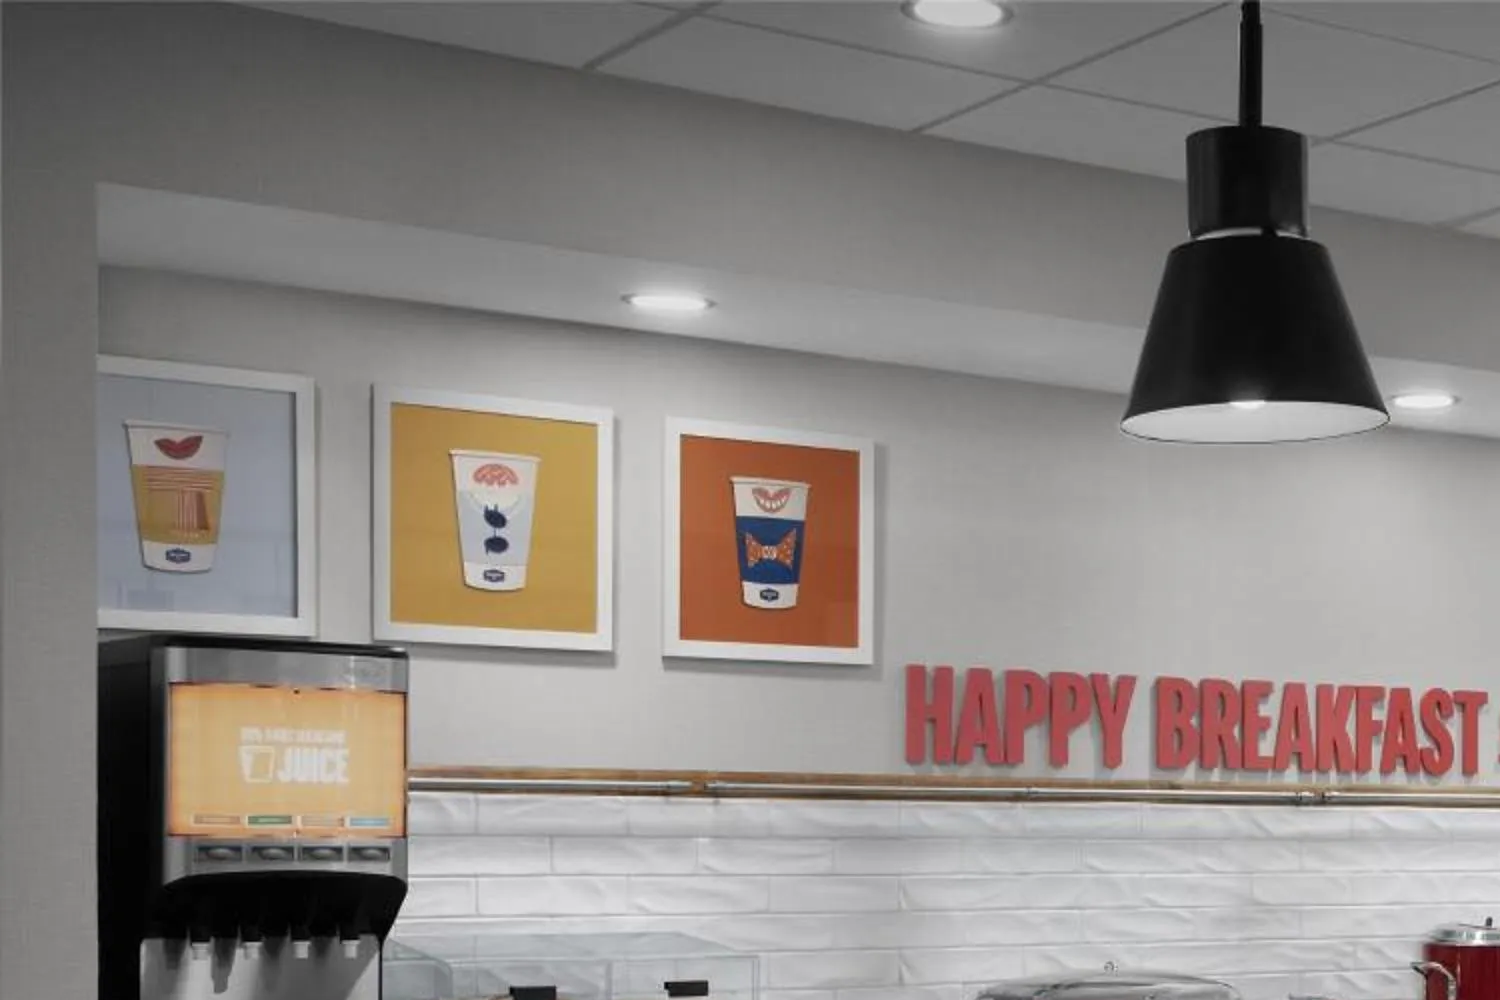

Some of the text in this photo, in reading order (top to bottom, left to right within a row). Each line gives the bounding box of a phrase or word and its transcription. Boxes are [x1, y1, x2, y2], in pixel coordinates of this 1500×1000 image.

[905, 664, 1137, 770] HAPPY
[1154, 676, 1489, 777] BREAKFAST
[277, 746, 350, 784] JUICE
